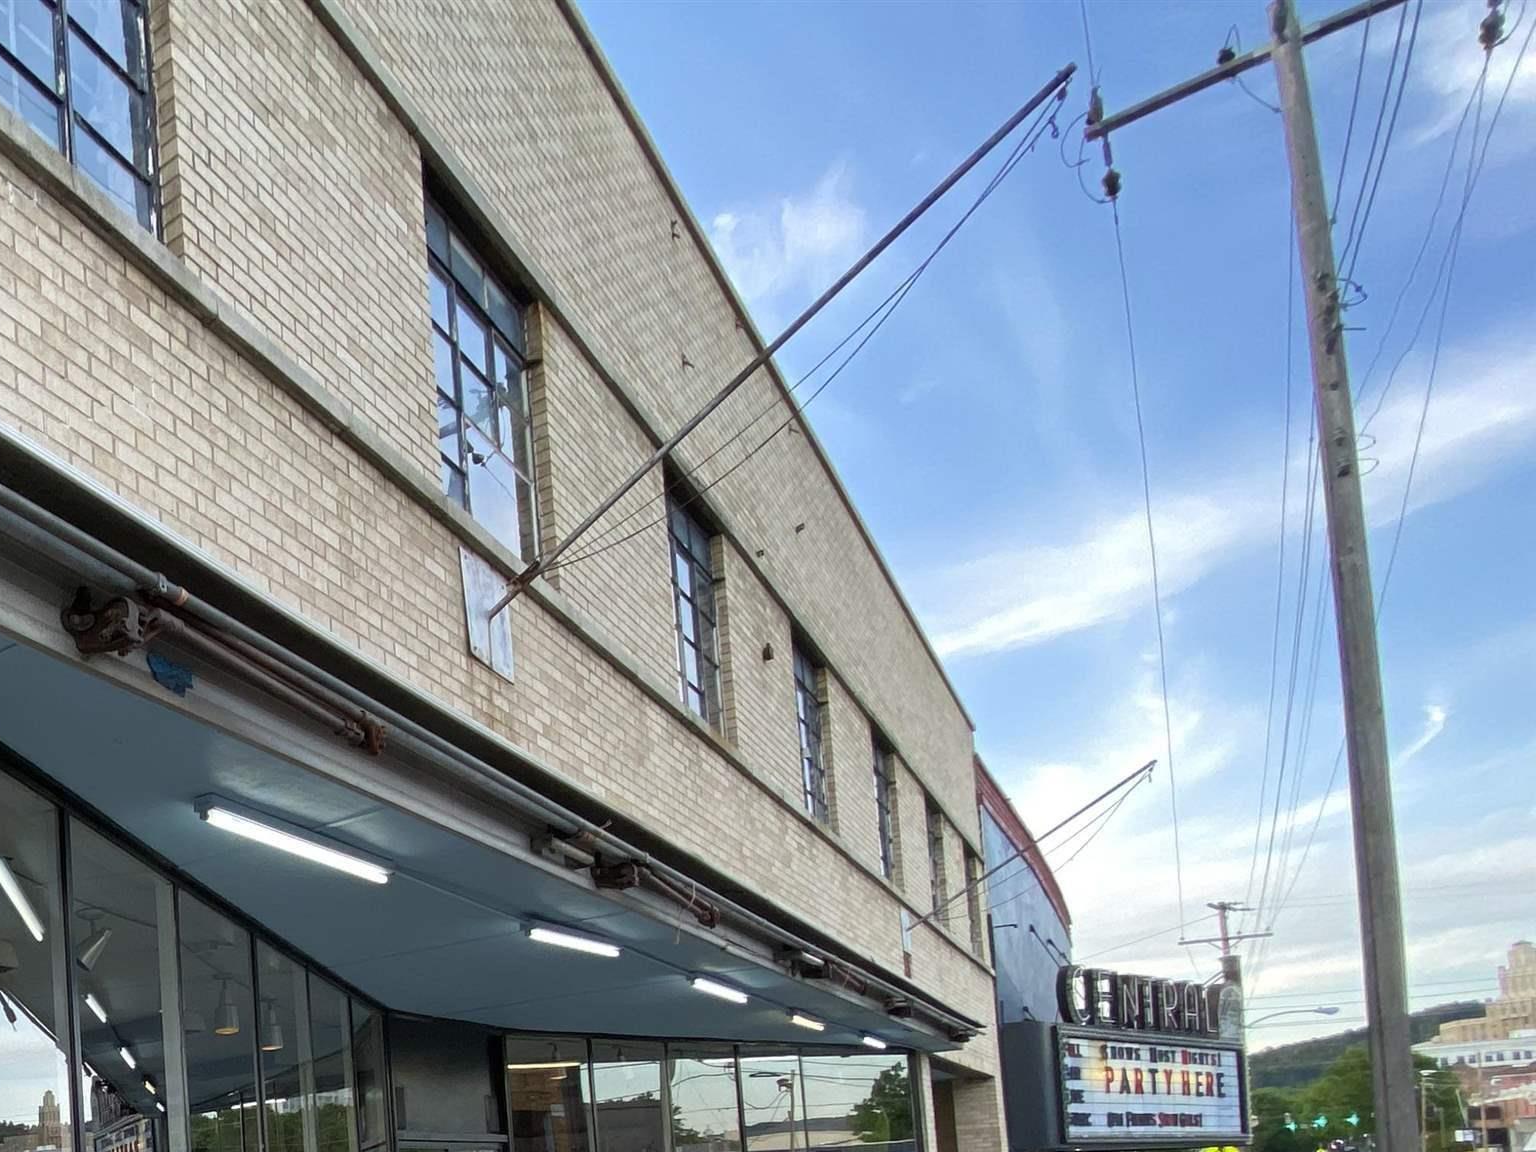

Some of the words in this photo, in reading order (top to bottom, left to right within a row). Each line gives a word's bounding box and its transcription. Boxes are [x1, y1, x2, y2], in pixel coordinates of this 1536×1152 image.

[1057, 964, 1220, 1035] CENTRAL
[1104, 1066, 1173, 1095] PARTY
[1181, 1070, 1226, 1098] HERE
